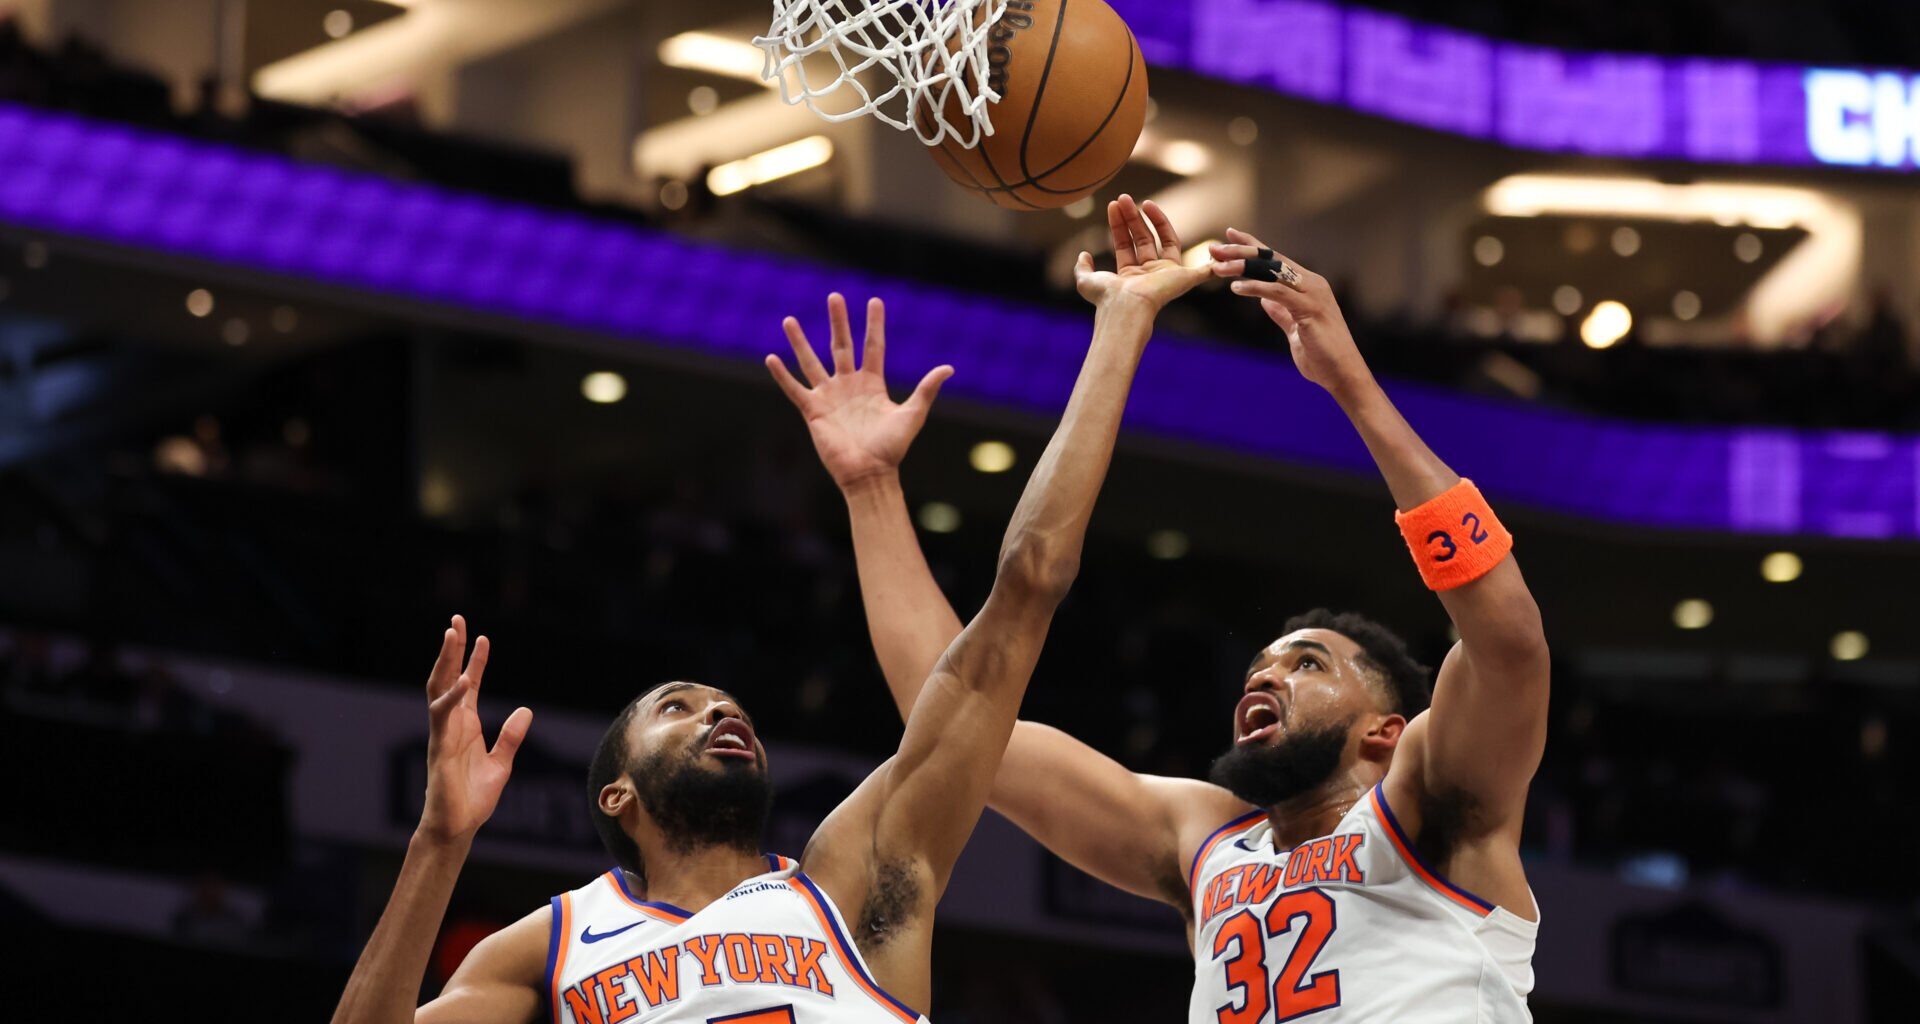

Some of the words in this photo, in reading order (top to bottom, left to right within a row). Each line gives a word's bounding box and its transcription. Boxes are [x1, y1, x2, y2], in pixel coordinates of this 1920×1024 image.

[988, 0, 1034, 97] ilson
[1201, 863, 1284, 927] NEW
[1283, 833, 1365, 887] ORK
[563, 944, 681, 1024] NEW
[683, 933, 834, 998] YORK
[1211, 886, 1341, 1024] 32
